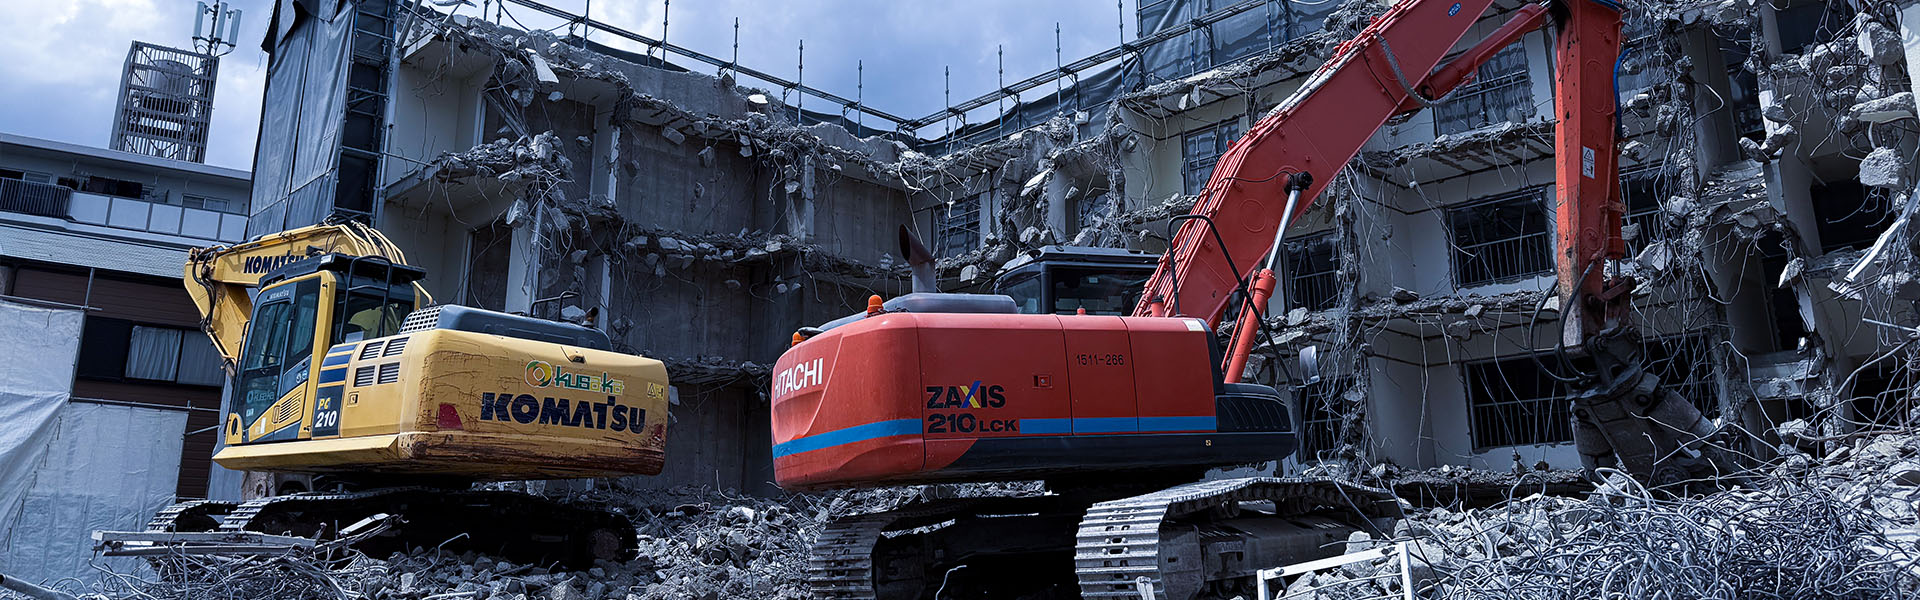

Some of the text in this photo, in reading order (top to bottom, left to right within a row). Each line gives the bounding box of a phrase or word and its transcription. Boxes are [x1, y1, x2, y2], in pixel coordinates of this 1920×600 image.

[1076, 354, 1125, 366] 1511-266
[775, 358, 824, 399] HITACHI
[317, 397, 332, 411] PC
[926, 380, 1006, 409] ZAXIS
[314, 410, 338, 428] 210
[480, 392, 646, 435] KOMATSU
